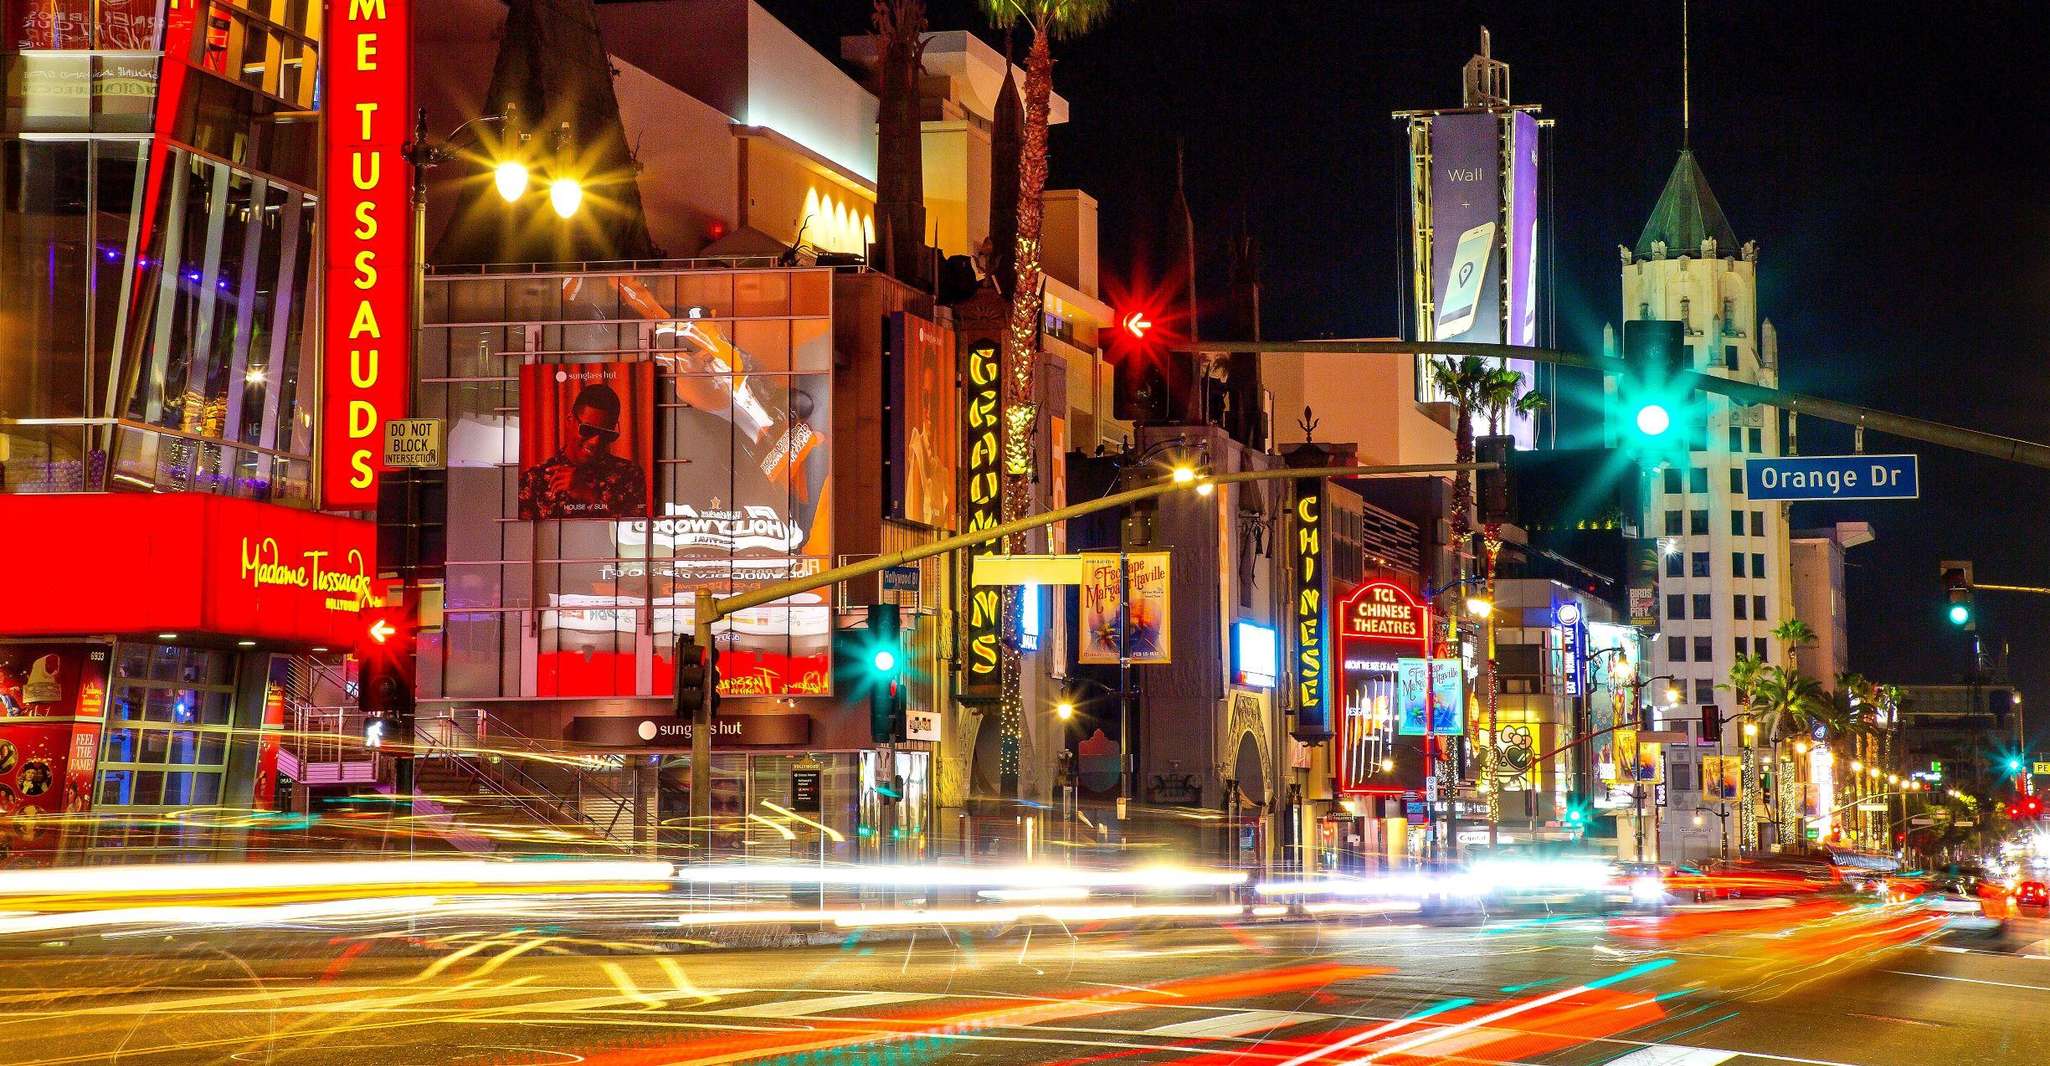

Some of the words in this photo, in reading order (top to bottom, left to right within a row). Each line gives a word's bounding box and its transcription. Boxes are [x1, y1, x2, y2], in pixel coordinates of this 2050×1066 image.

[1447, 167, 1483, 182] Wall
[349, 102, 381, 490] TUSSAUDS
[568, 371, 603, 381] sunglass
[603, 369, 617, 379] hut
[391, 423, 405, 437] DO
[411, 423, 433, 437] NOT
[393, 439, 428, 452] BLOCK
[384, 452, 436, 464] INTERSECTION
[1761, 466, 1858, 494] Orange
[1871, 464, 1902, 487] Dr
[563, 503, 586, 511] HOUSE
[969, 348, 999, 674] GRAUMNS
[241, 536, 309, 588] Madame
[303, 549, 371, 604] Tussauds
[884, 570, 912, 588] Hollywood
[1373, 588, 1397, 602] TCL
[1629, 588, 1653, 598] BIRDS
[1298, 495, 1321, 708] CHINESE
[1358, 602, 1412, 619] CHINESE
[1353, 618, 1417, 635] THEATRES
[1563, 627, 1575, 645] PLAY
[90, 651, 105, 661] 6933
[660, 724, 717, 739] sungs
[720, 720, 742, 734] hut
[75, 733, 95, 746] FEEL
[77, 746, 93, 758] THE
